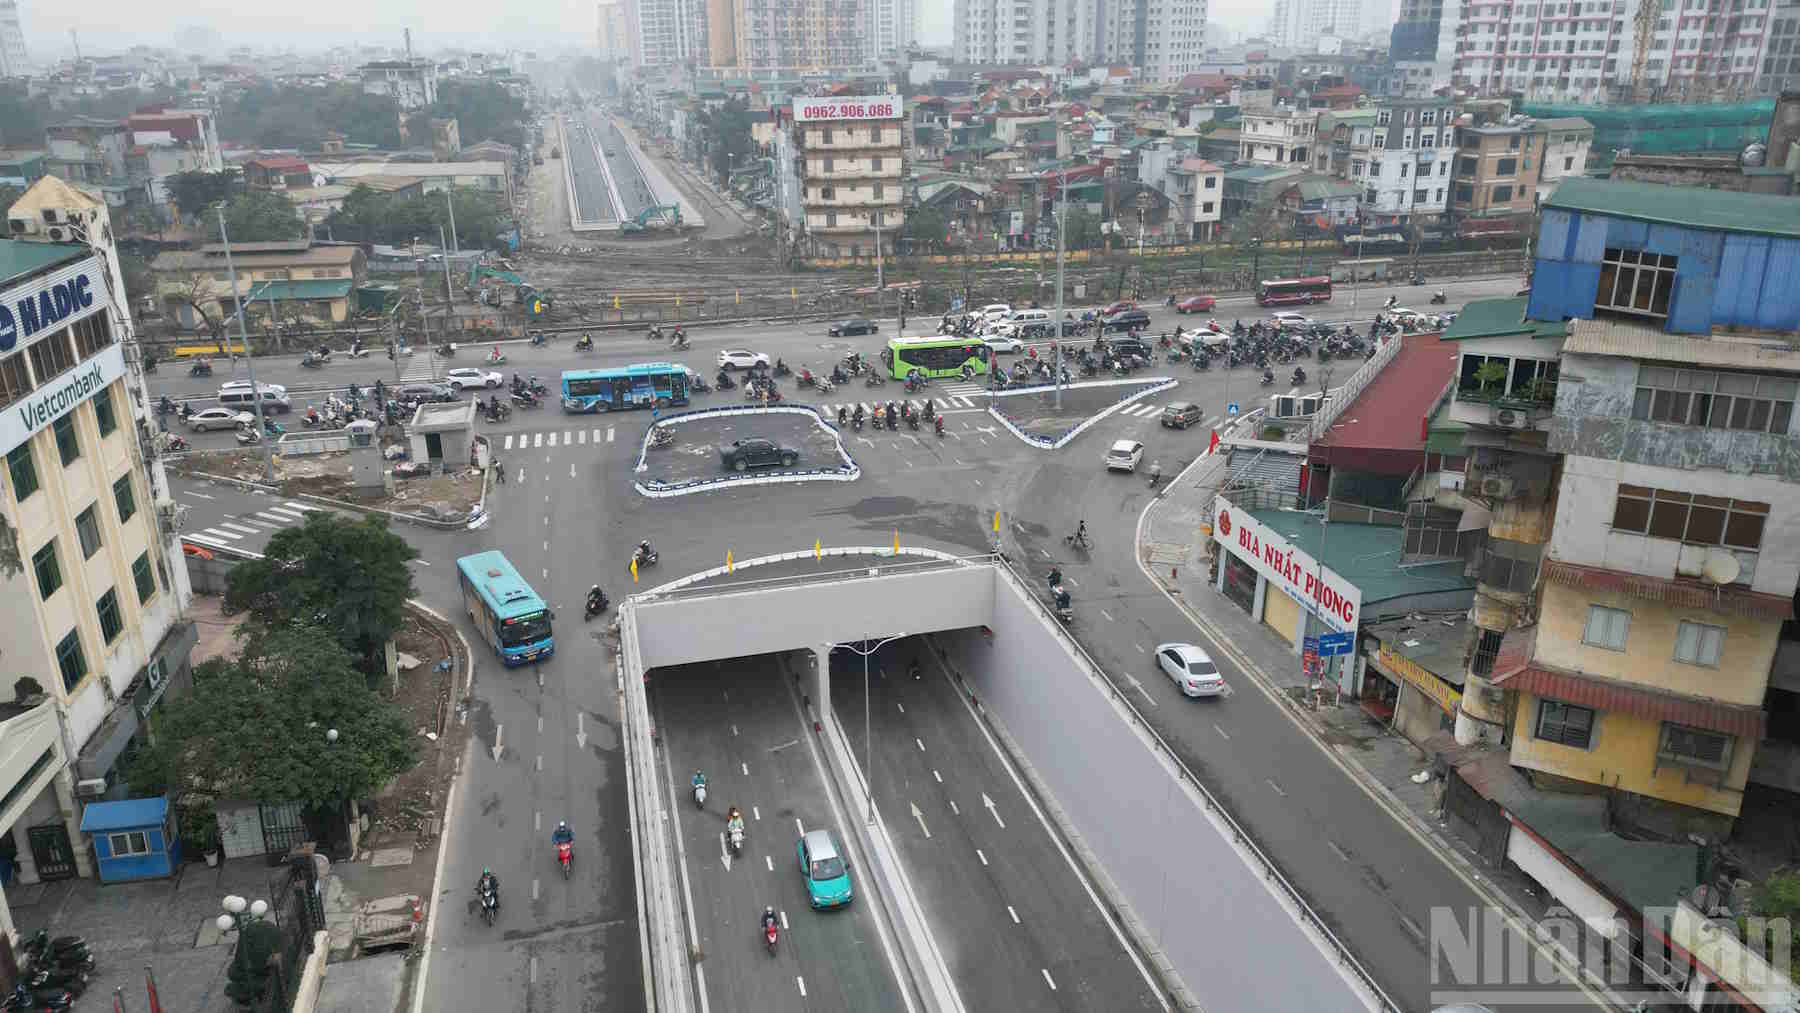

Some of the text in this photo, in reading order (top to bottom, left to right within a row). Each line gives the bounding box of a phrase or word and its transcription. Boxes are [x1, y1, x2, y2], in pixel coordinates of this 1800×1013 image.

[803, 104, 893, 119] 0962.906.086
[17, 273, 93, 337] HADIC
[19, 361, 104, 432] Vietcombank
[1239, 526, 1260, 558] BIA
[1264, 543, 1302, 586] NHẤT
